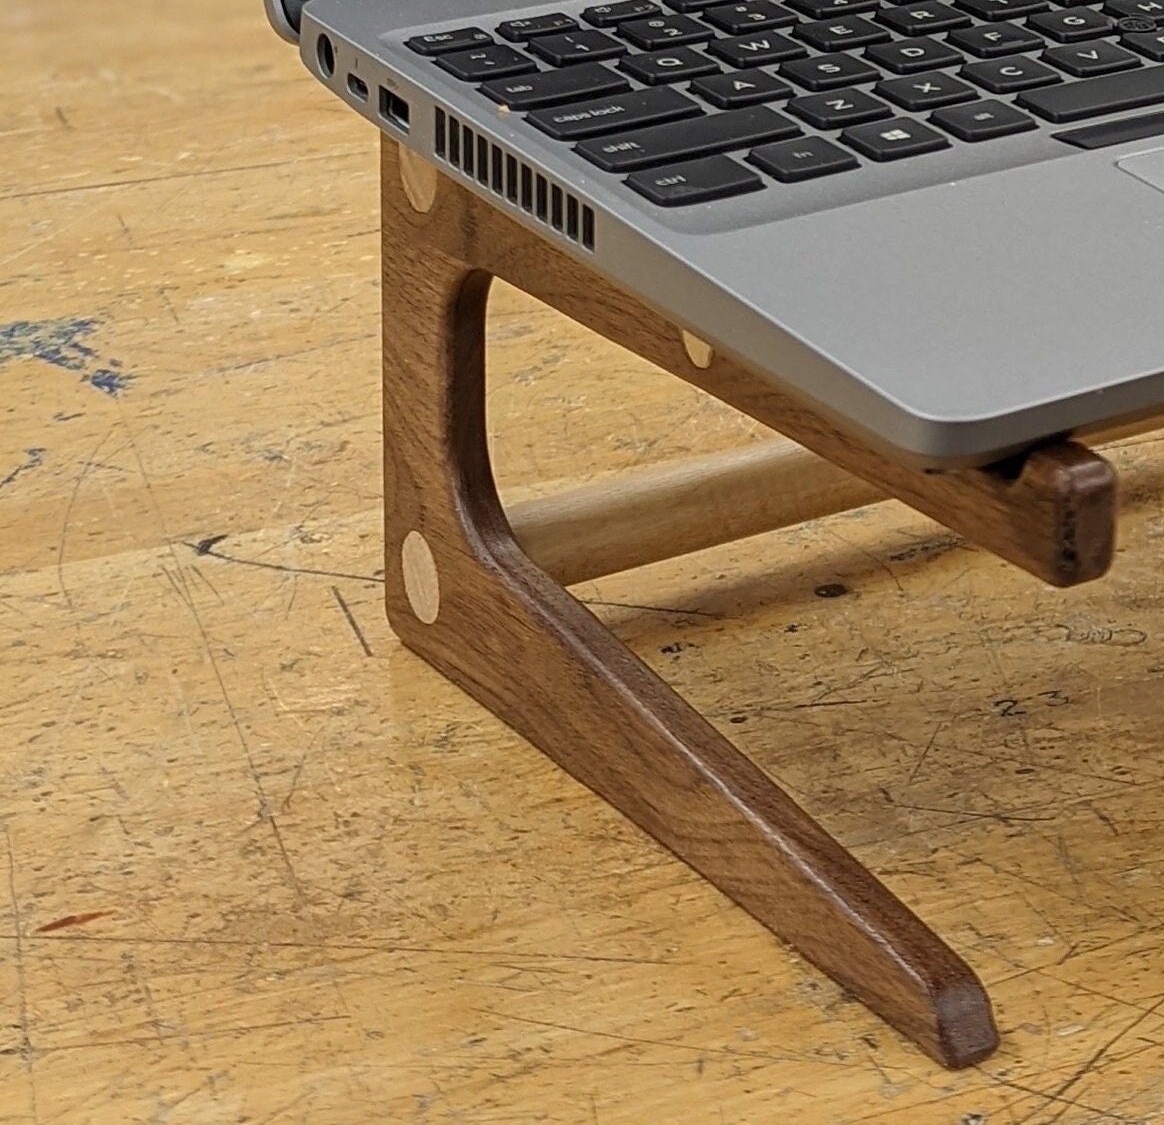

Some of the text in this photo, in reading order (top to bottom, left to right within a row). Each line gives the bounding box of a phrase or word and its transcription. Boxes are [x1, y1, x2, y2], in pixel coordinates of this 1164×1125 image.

[1136, 1, 1164, 12] H
[910, 10, 936, 21] R
[1062, 16, 1086, 26] G
[664, 28, 684, 37] 2
[829, 25, 854, 36] E
[983, 31, 1003, 42] F
[738, 39, 771, 53] W
[900, 47, 926, 58] D
[1076, 49, 1099, 60] V
[656, 57, 684, 68] Q
[817, 63, 841, 74] S
[1000, 66, 1024, 76] C
[506, 84, 534, 94] tab
[733, 80, 757, 91] A
[912, 82, 942, 94] X
[825, 98, 855, 111] Z
[553, 104, 626, 124] caps lock
[602, 140, 641, 153] shift
[655, 174, 688, 186] ctrl
